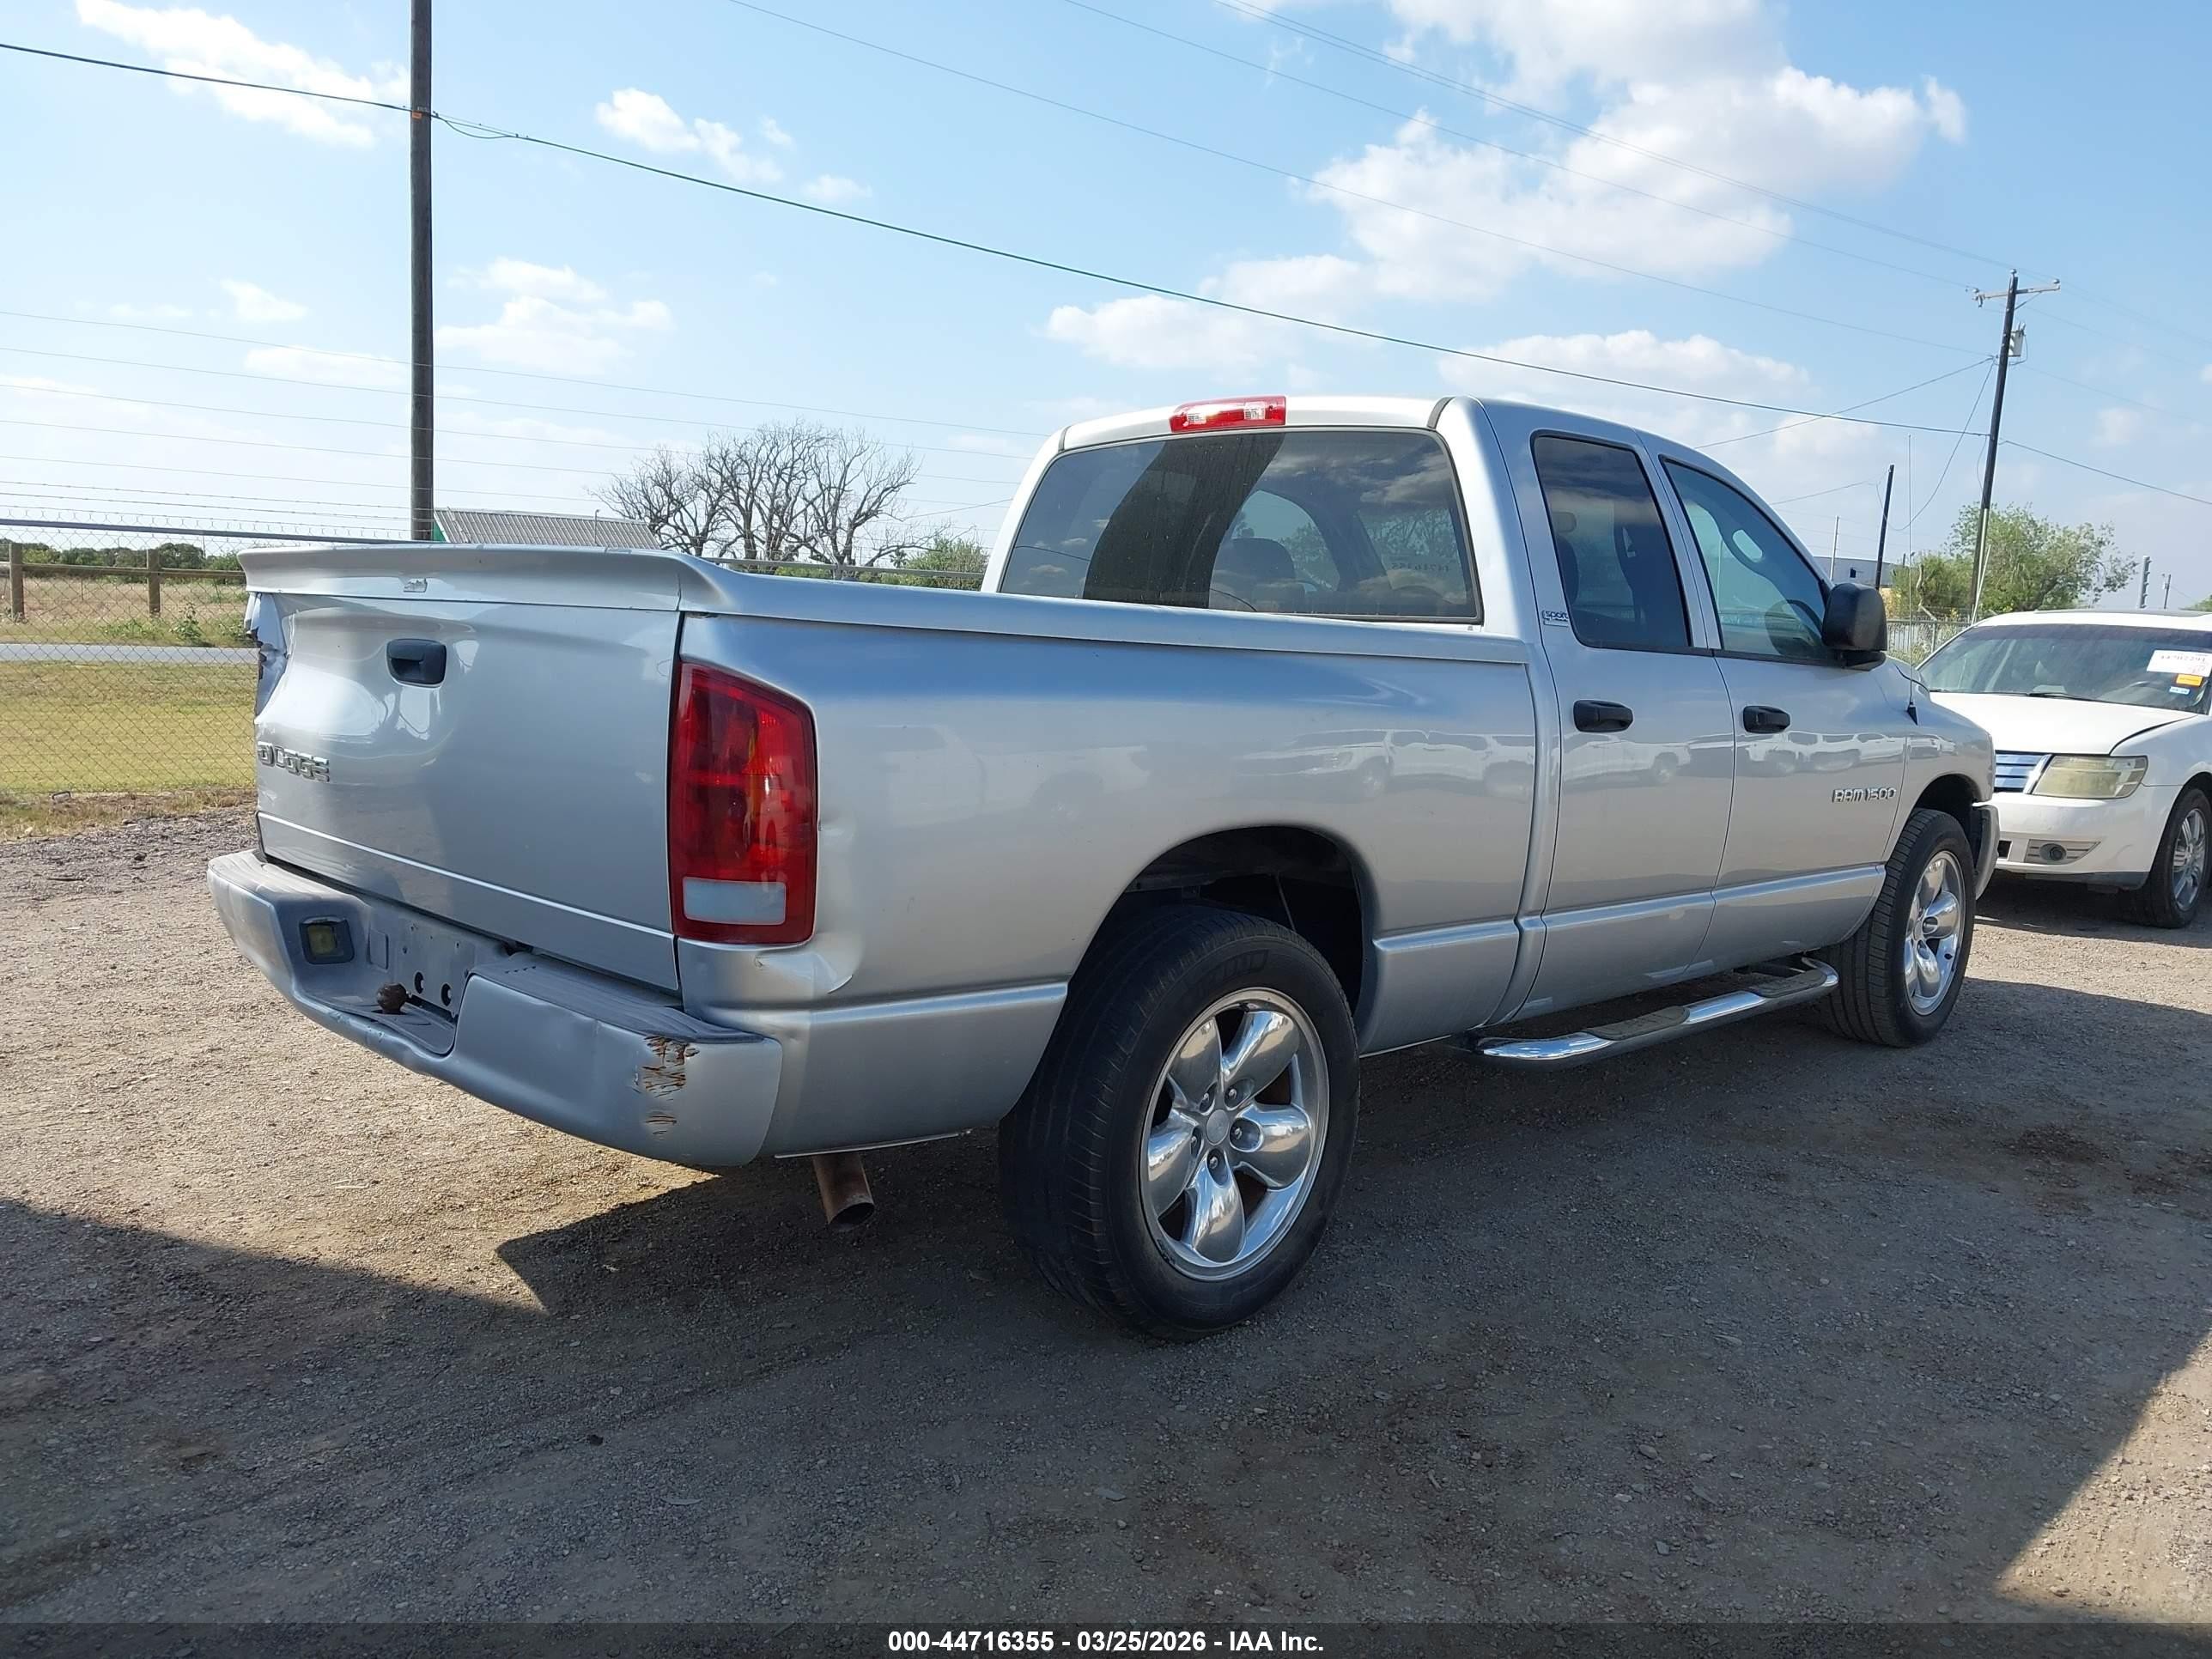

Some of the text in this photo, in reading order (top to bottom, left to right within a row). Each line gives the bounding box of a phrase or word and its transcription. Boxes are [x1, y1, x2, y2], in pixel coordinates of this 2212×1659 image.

[258, 740, 330, 782] DODGE
[1832, 787, 1897, 803] RAM 1500
